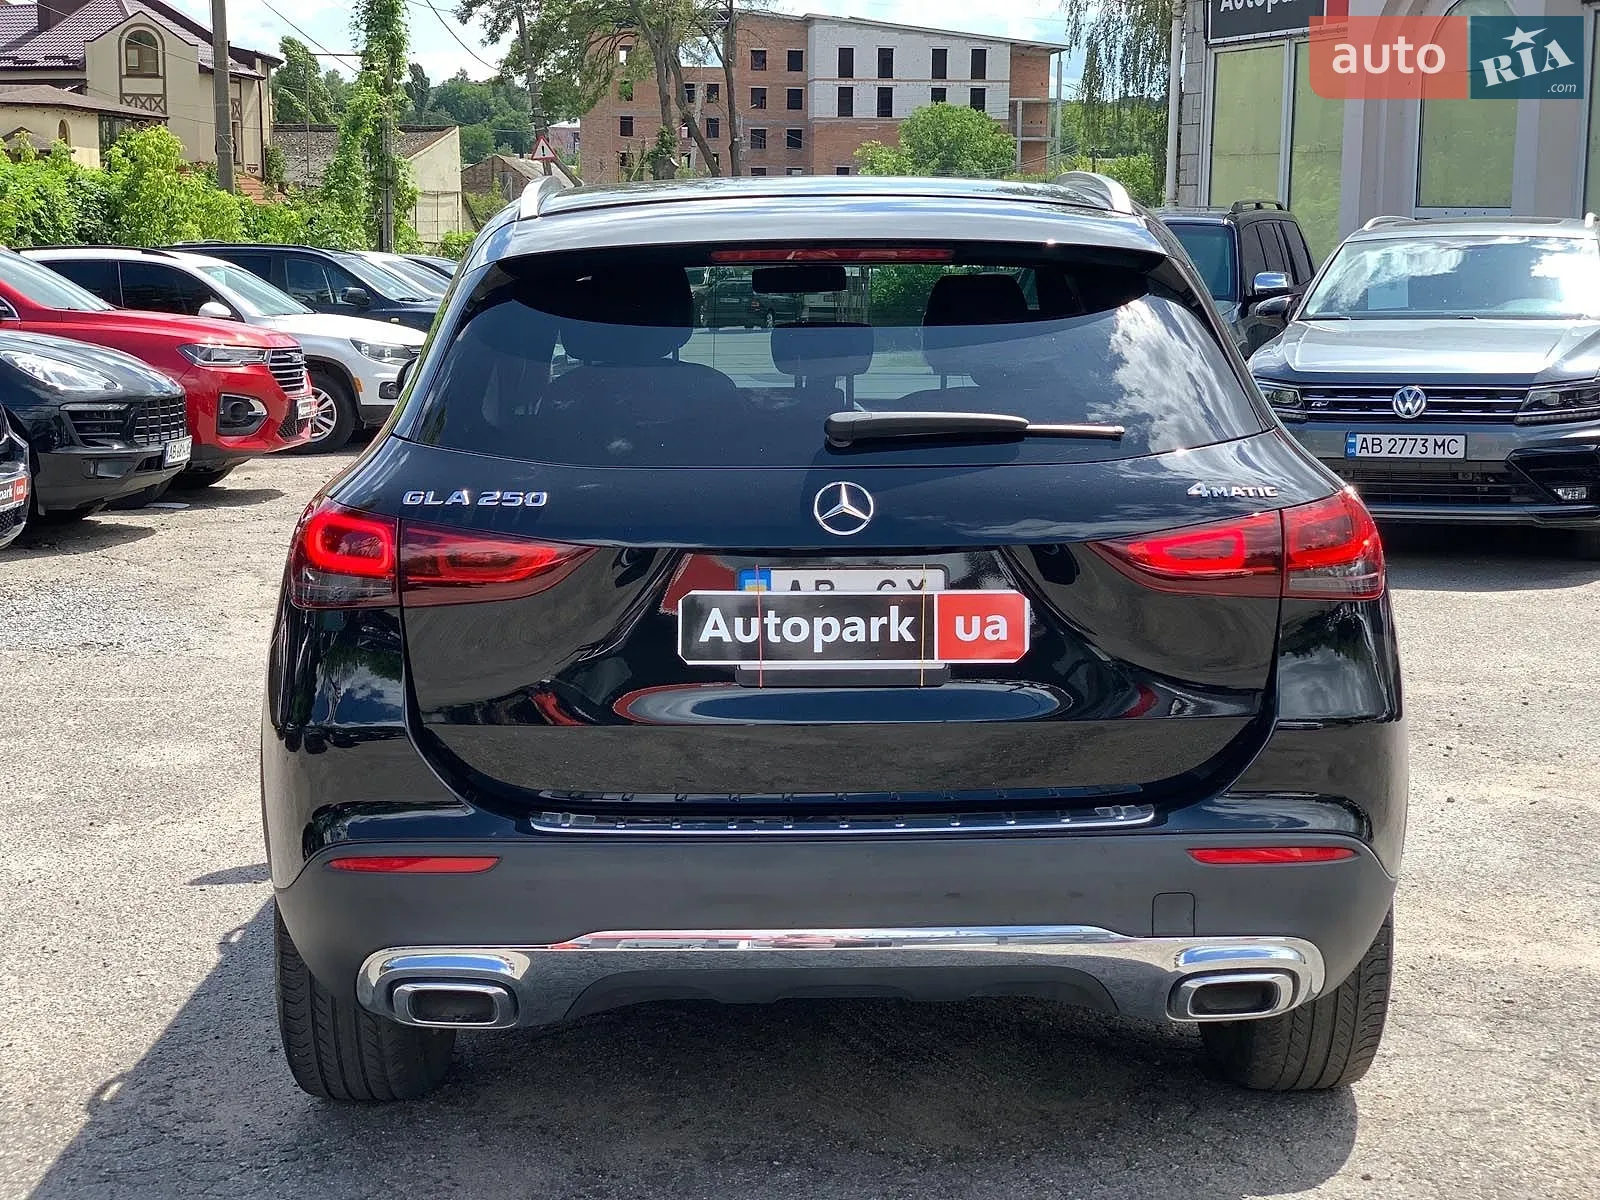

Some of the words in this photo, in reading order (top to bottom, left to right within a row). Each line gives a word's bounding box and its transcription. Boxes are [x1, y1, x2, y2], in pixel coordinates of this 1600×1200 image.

[1358, 438, 1383, 454] AB
[1387, 438, 1429, 455] 2773
[1433, 438, 1459, 455] MC
[1187, 482, 1279, 497] 4MATIC
[402, 490, 470, 506] GLA
[477, 491, 548, 507] 250
[699, 606, 916, 652] Autopark
[954, 614, 1008, 641] ua
